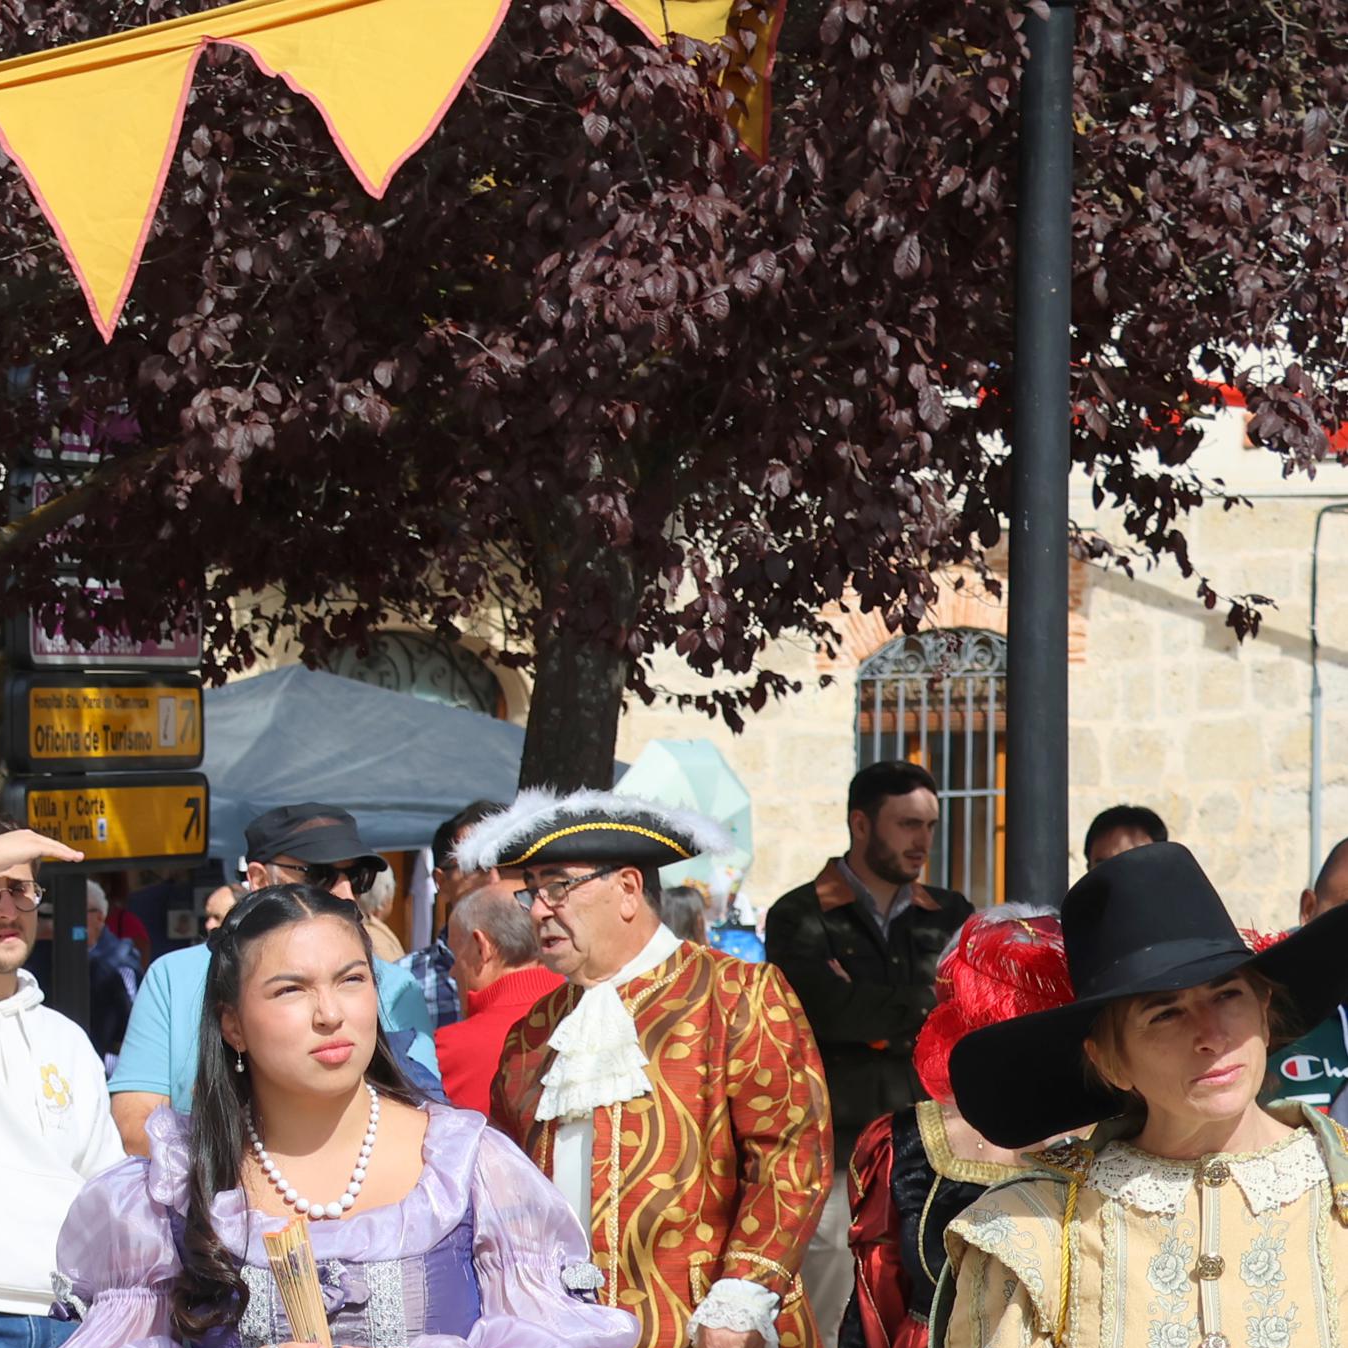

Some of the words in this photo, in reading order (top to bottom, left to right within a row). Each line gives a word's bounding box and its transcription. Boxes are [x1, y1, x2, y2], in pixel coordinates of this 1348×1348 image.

[35, 724, 80, 752] Oficina
[84, 724, 100, 751] de
[102, 724, 153, 750] Turismo
[33, 796, 58, 817] Villa
[63, 800, 70, 820] y
[76, 795, 105, 815] Corte
[68, 820, 93, 841] rural
